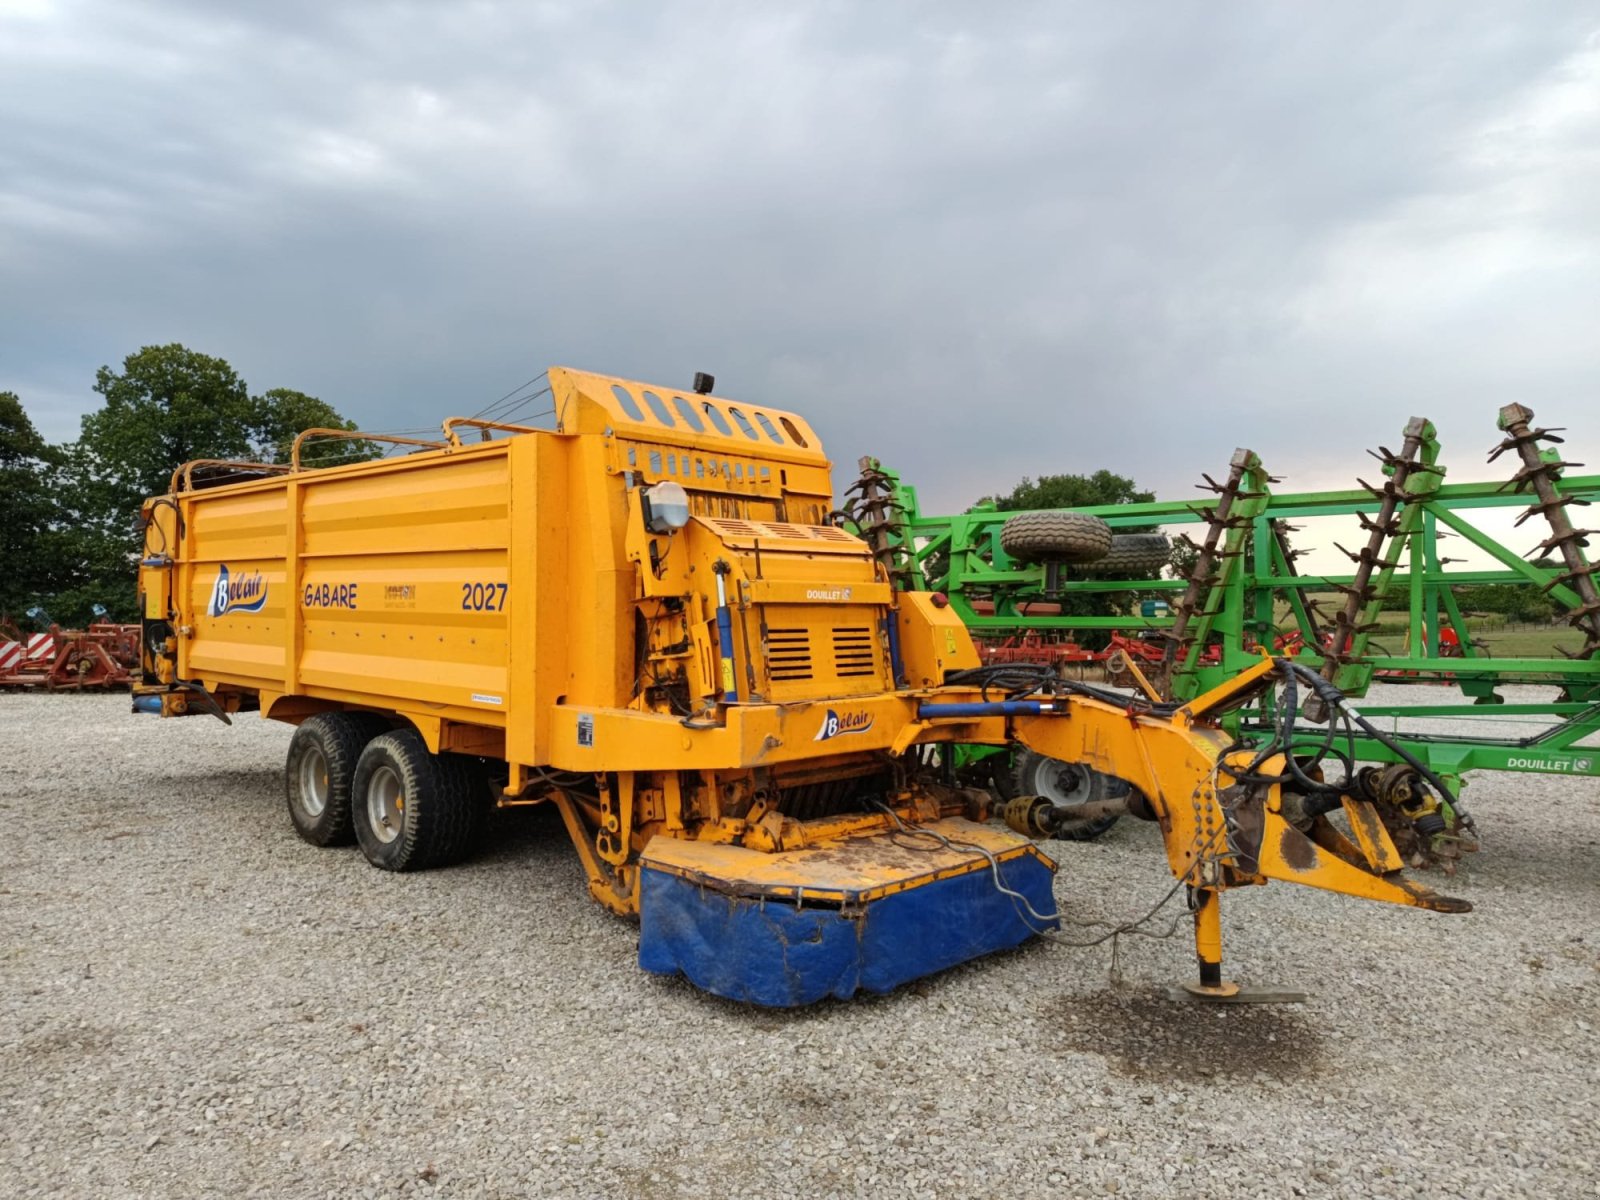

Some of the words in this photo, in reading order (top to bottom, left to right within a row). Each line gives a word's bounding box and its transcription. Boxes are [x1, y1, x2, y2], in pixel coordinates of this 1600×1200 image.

[304, 583, 357, 609] GABARE
[462, 582, 508, 612] 2027
[806, 590, 840, 600] DOUILLET
[1507, 757, 1569, 771] DOUILLET
